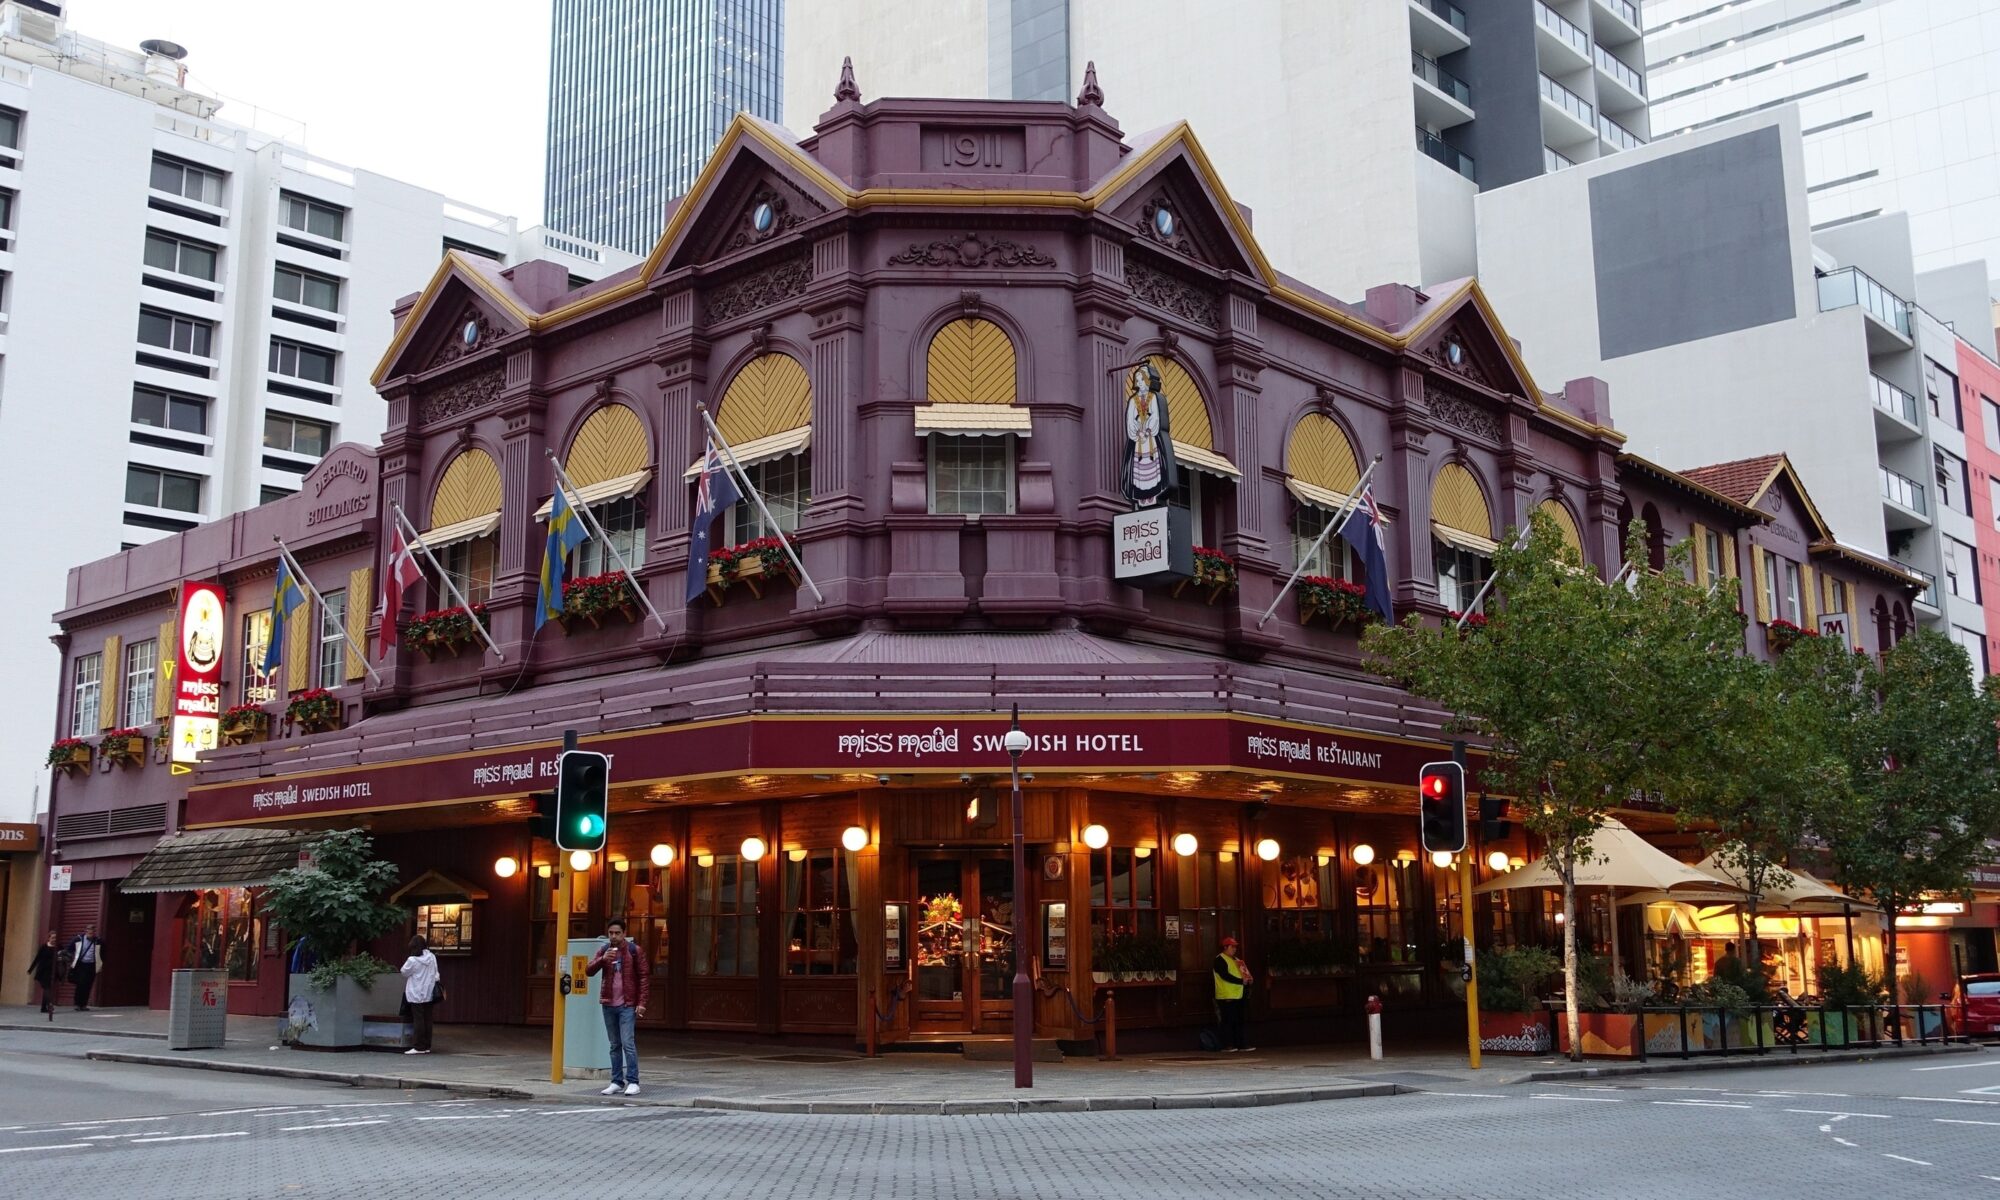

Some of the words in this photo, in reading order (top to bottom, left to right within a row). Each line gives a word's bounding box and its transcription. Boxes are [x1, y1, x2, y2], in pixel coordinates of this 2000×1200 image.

[943, 133, 1002, 168] 1911
[1123, 519, 1160, 543] miss
[182, 678, 219, 696] miss
[838, 728, 893, 758] miss
[972, 734, 1067, 752] SWDISH
[1076, 734, 1143, 752] HOTEL
[1247, 731, 1278, 760] miss
[1317, 743, 1382, 769] RESTAURANT
[473, 762, 501, 788] miss
[252, 788, 274, 811] miss
[301, 786, 341, 802] SWEDISH
[342, 782, 371, 798] HOTEL
